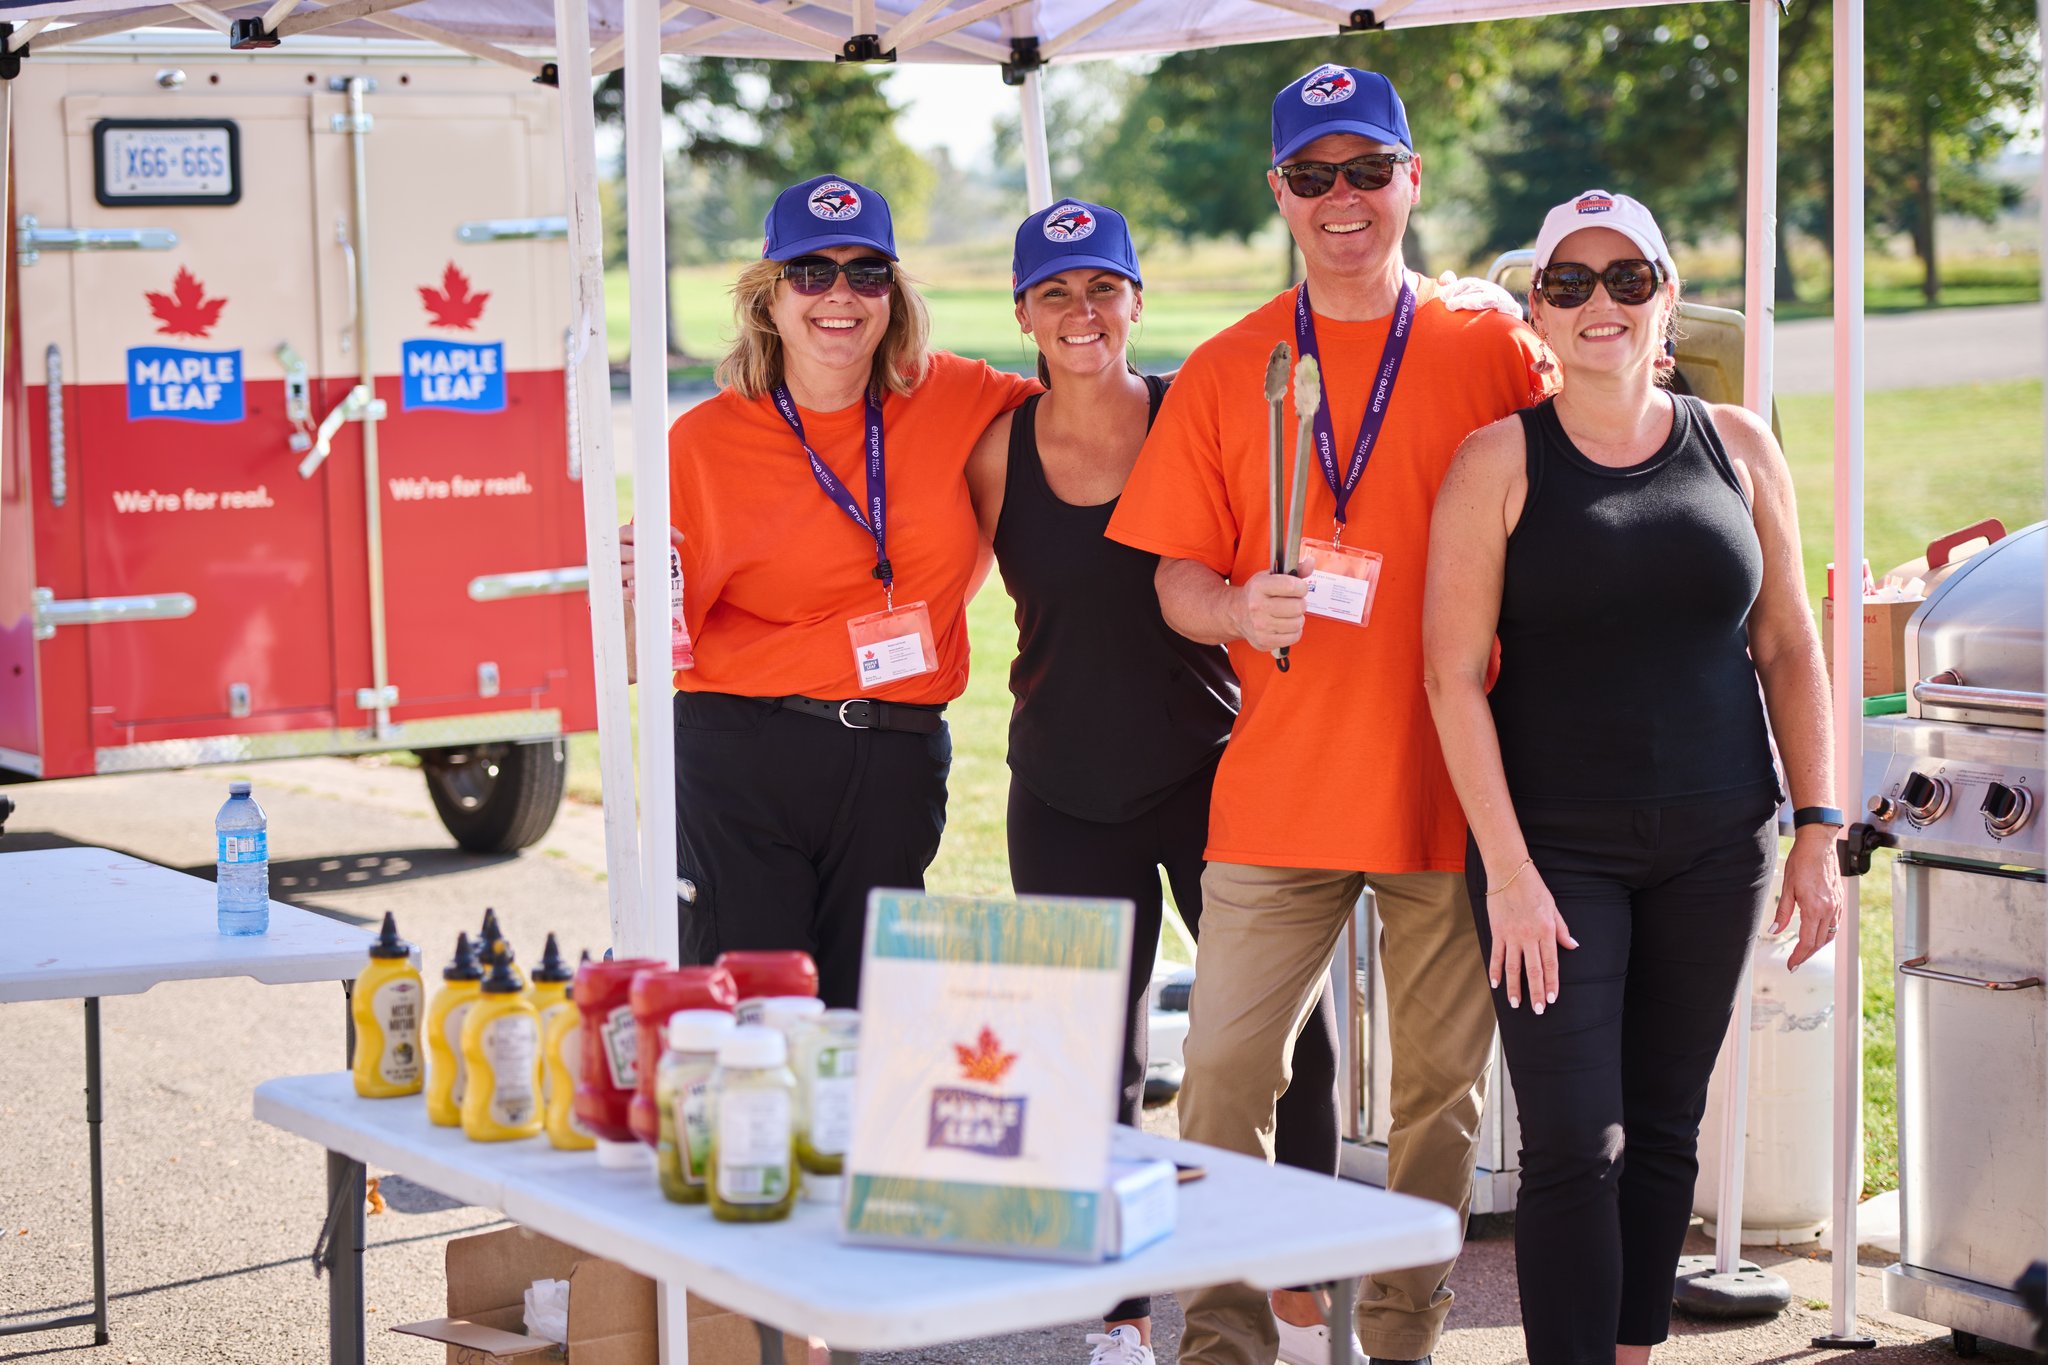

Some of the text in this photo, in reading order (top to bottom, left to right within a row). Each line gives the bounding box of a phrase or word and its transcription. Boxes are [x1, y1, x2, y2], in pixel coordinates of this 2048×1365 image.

[1307, 70, 1341, 87] TORONTO
[1306, 88, 1350, 102] BLUE JAYS
[813, 184, 845, 199] TORONTO
[814, 205, 856, 218] BLUE JAYS
[1048, 207, 1080, 223] TORONTO
[1048, 225, 1091, 240] BLUE JAYS
[1395, 304, 1409, 338] empire
[135, 357, 235, 385] MAPLE
[408, 348, 498, 377] MAPLE
[149, 383, 222, 411] LEAF
[421, 375, 487, 402] LEAF
[1372, 378, 1388, 413] empire
[780, 399, 799, 427] empire
[870, 425, 880, 458] empire
[1320, 431, 1333, 468] empire
[389, 471, 533, 501] We're for real.
[1346, 454, 1363, 490] empire
[112, 484, 275, 513] We're for real.
[872, 496, 882, 530] empire
[938, 1098, 1018, 1127] MAPLE
[943, 1121, 1008, 1148] LEAF
